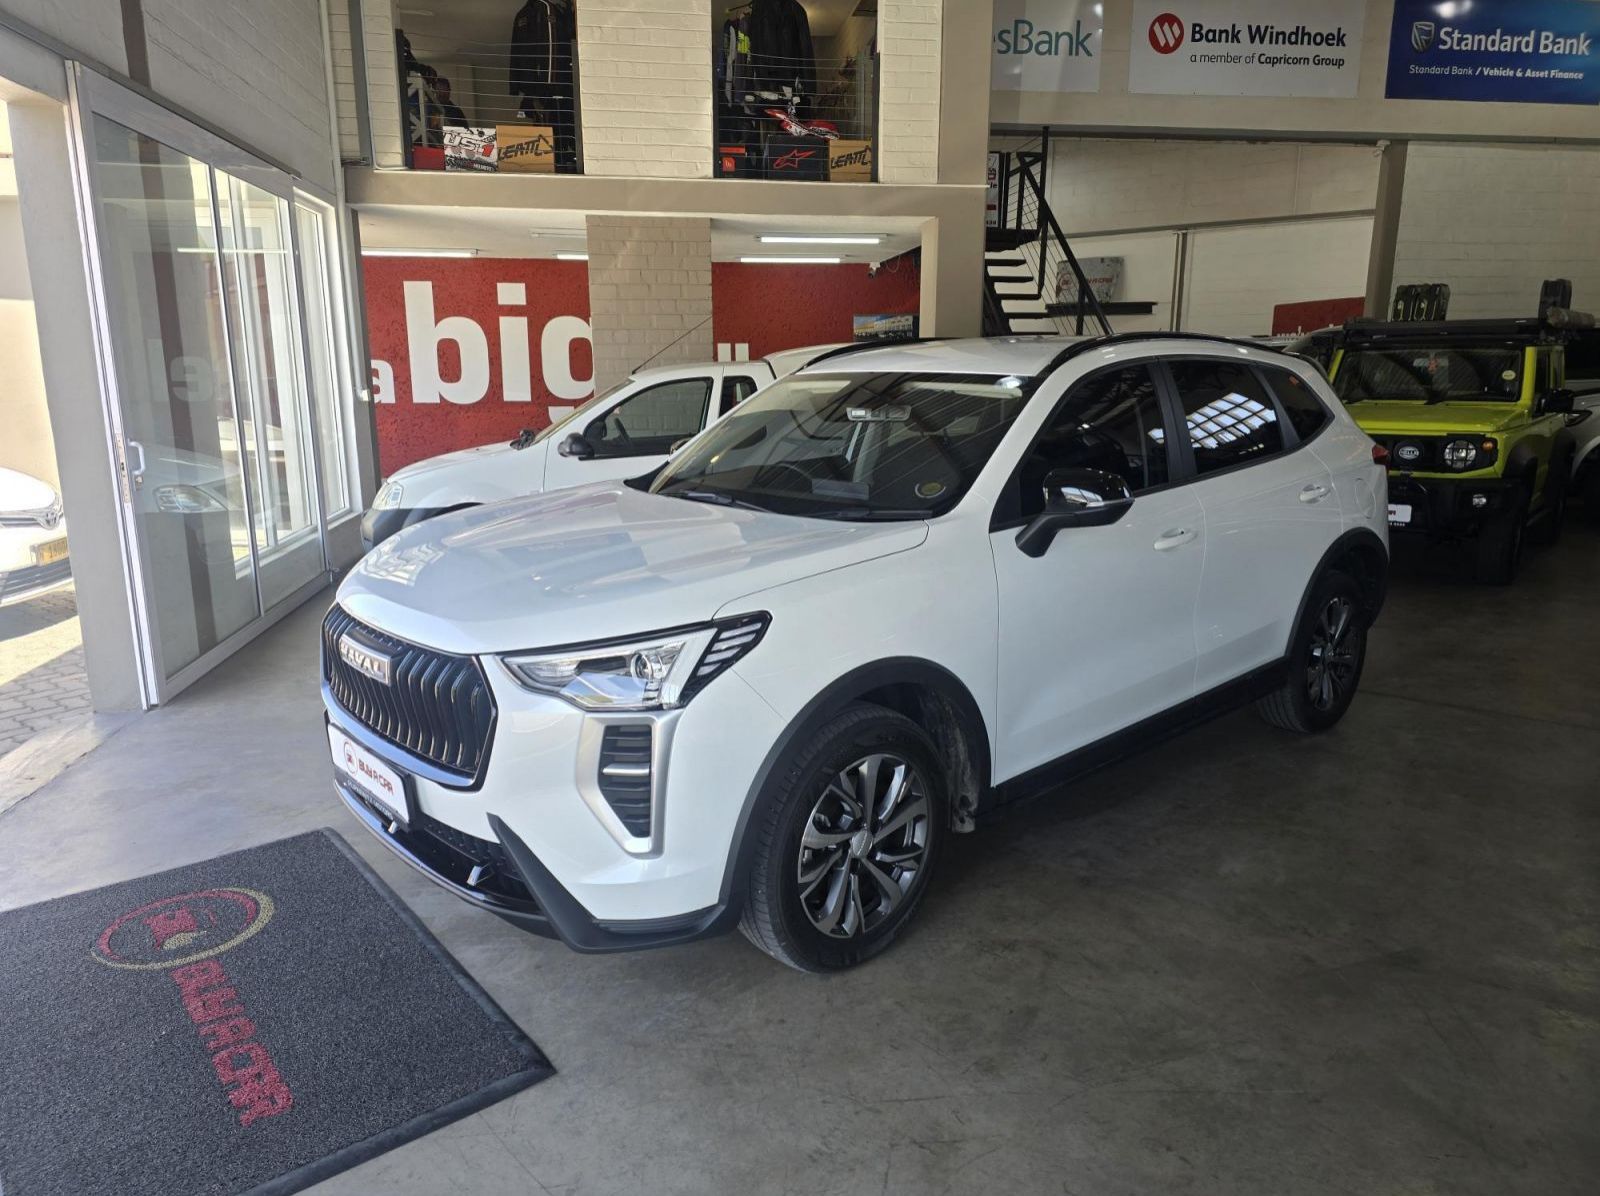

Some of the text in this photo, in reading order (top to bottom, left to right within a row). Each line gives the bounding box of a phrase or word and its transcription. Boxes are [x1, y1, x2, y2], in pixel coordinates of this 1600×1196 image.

[993, 19, 1093, 57] sBank
[1191, 23, 1347, 47] Bank Windhoek
[1438, 27, 1592, 56] Standard Bank
[1190, 52, 1345, 69] a member of Capricorn Group
[1409, 64, 1584, 80] Standard Bank / Vehicle & Asset Finance
[403, 280, 596, 424] big
[340, 639, 385, 680] HAVAL
